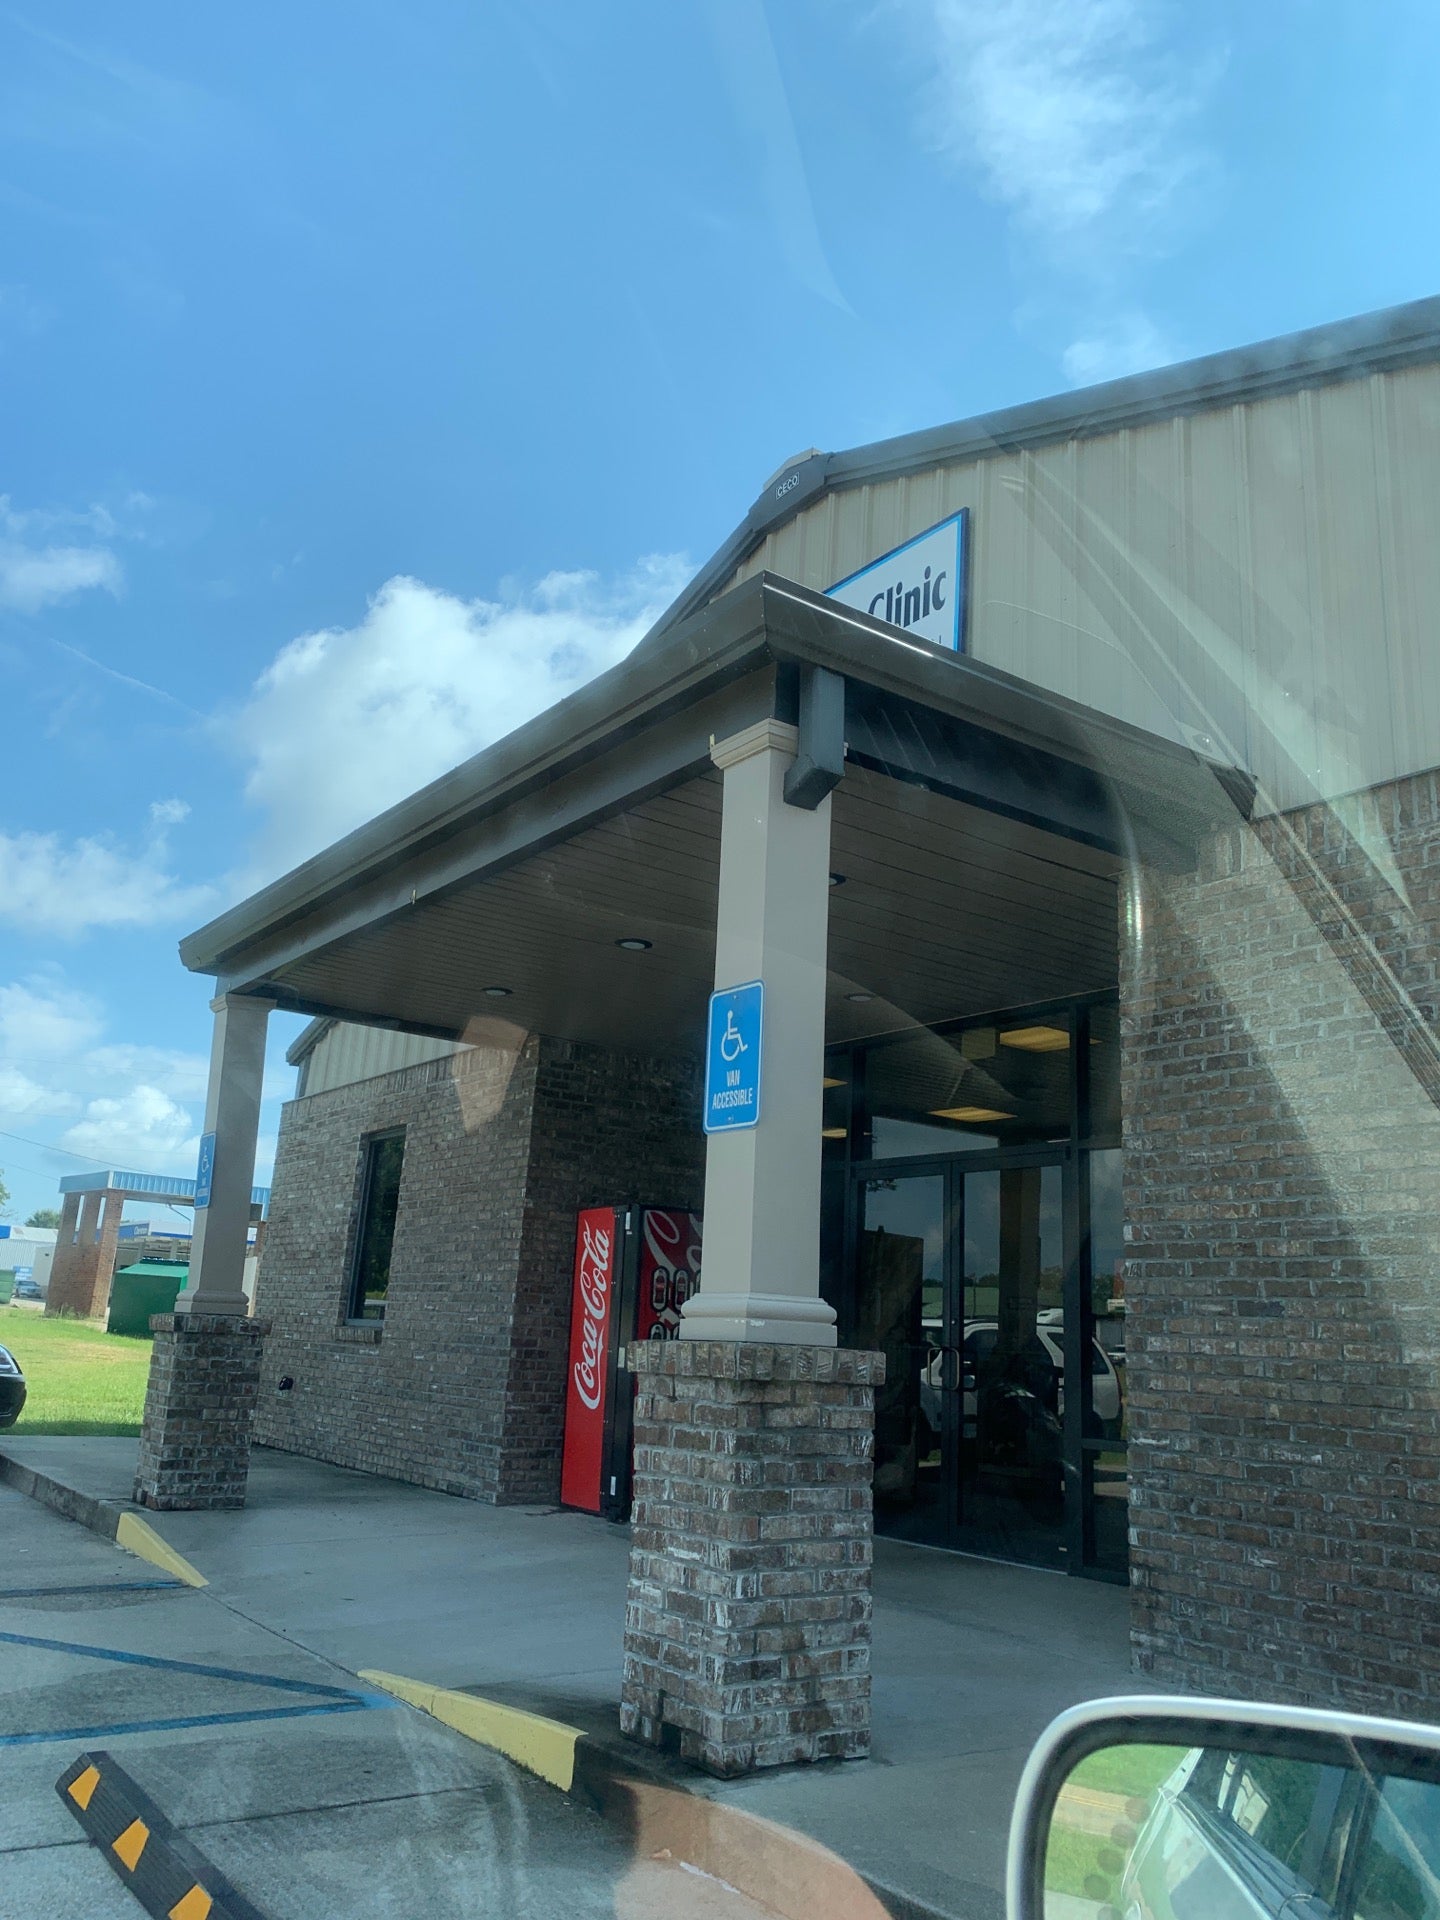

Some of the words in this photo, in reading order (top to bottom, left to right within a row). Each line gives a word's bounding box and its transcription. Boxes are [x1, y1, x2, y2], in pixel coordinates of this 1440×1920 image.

[777, 474, 798, 497] CECO
[868, 565, 947, 628] Clinic
[726, 1069, 741, 1088] VAN
[712, 1087, 753, 1110] ACCESSIBLE
